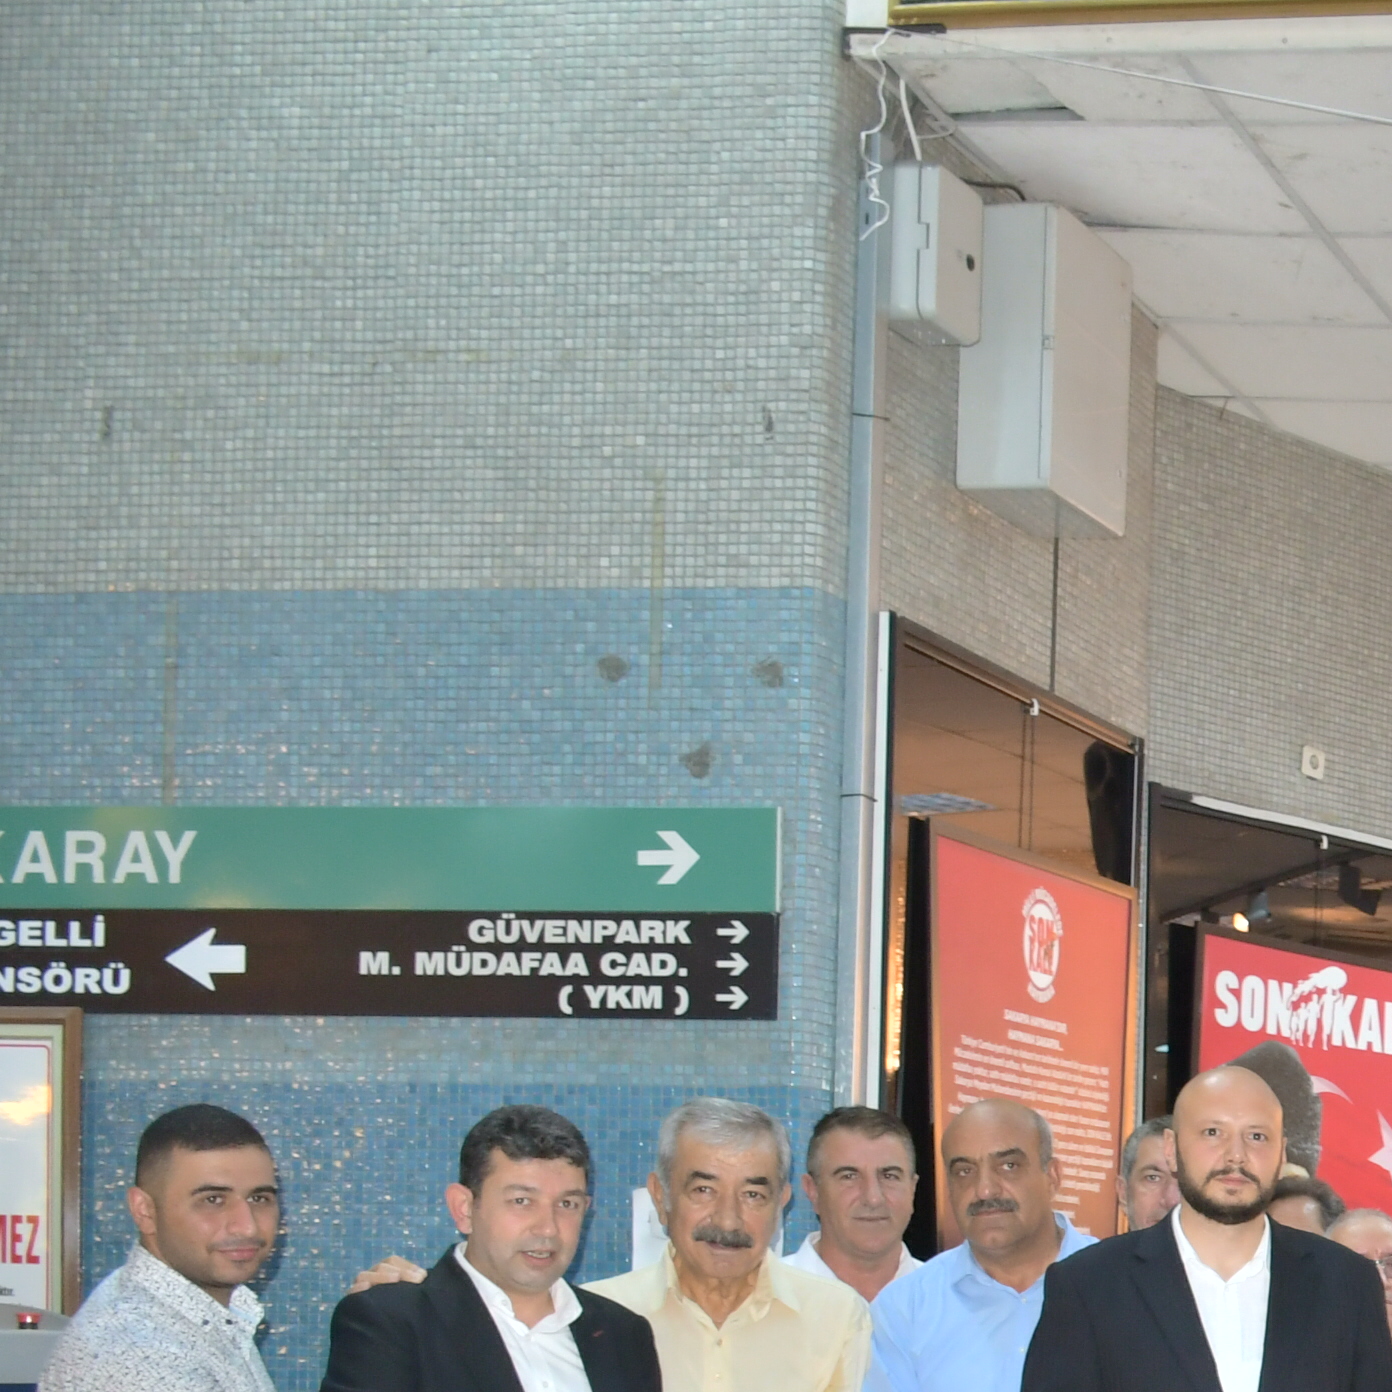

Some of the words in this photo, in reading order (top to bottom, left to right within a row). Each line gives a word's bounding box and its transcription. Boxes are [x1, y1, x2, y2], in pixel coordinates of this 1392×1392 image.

[0, 831, 197, 884] ARAY
[468, 913, 692, 944] GÜVENPARK
[359, 951, 401, 975] M.
[414, 945, 590, 976] MÜDAFAA
[600, 952, 688, 977] CAD.
[584, 985, 662, 1009] YKM
[1214, 970, 1293, 1038] SON
